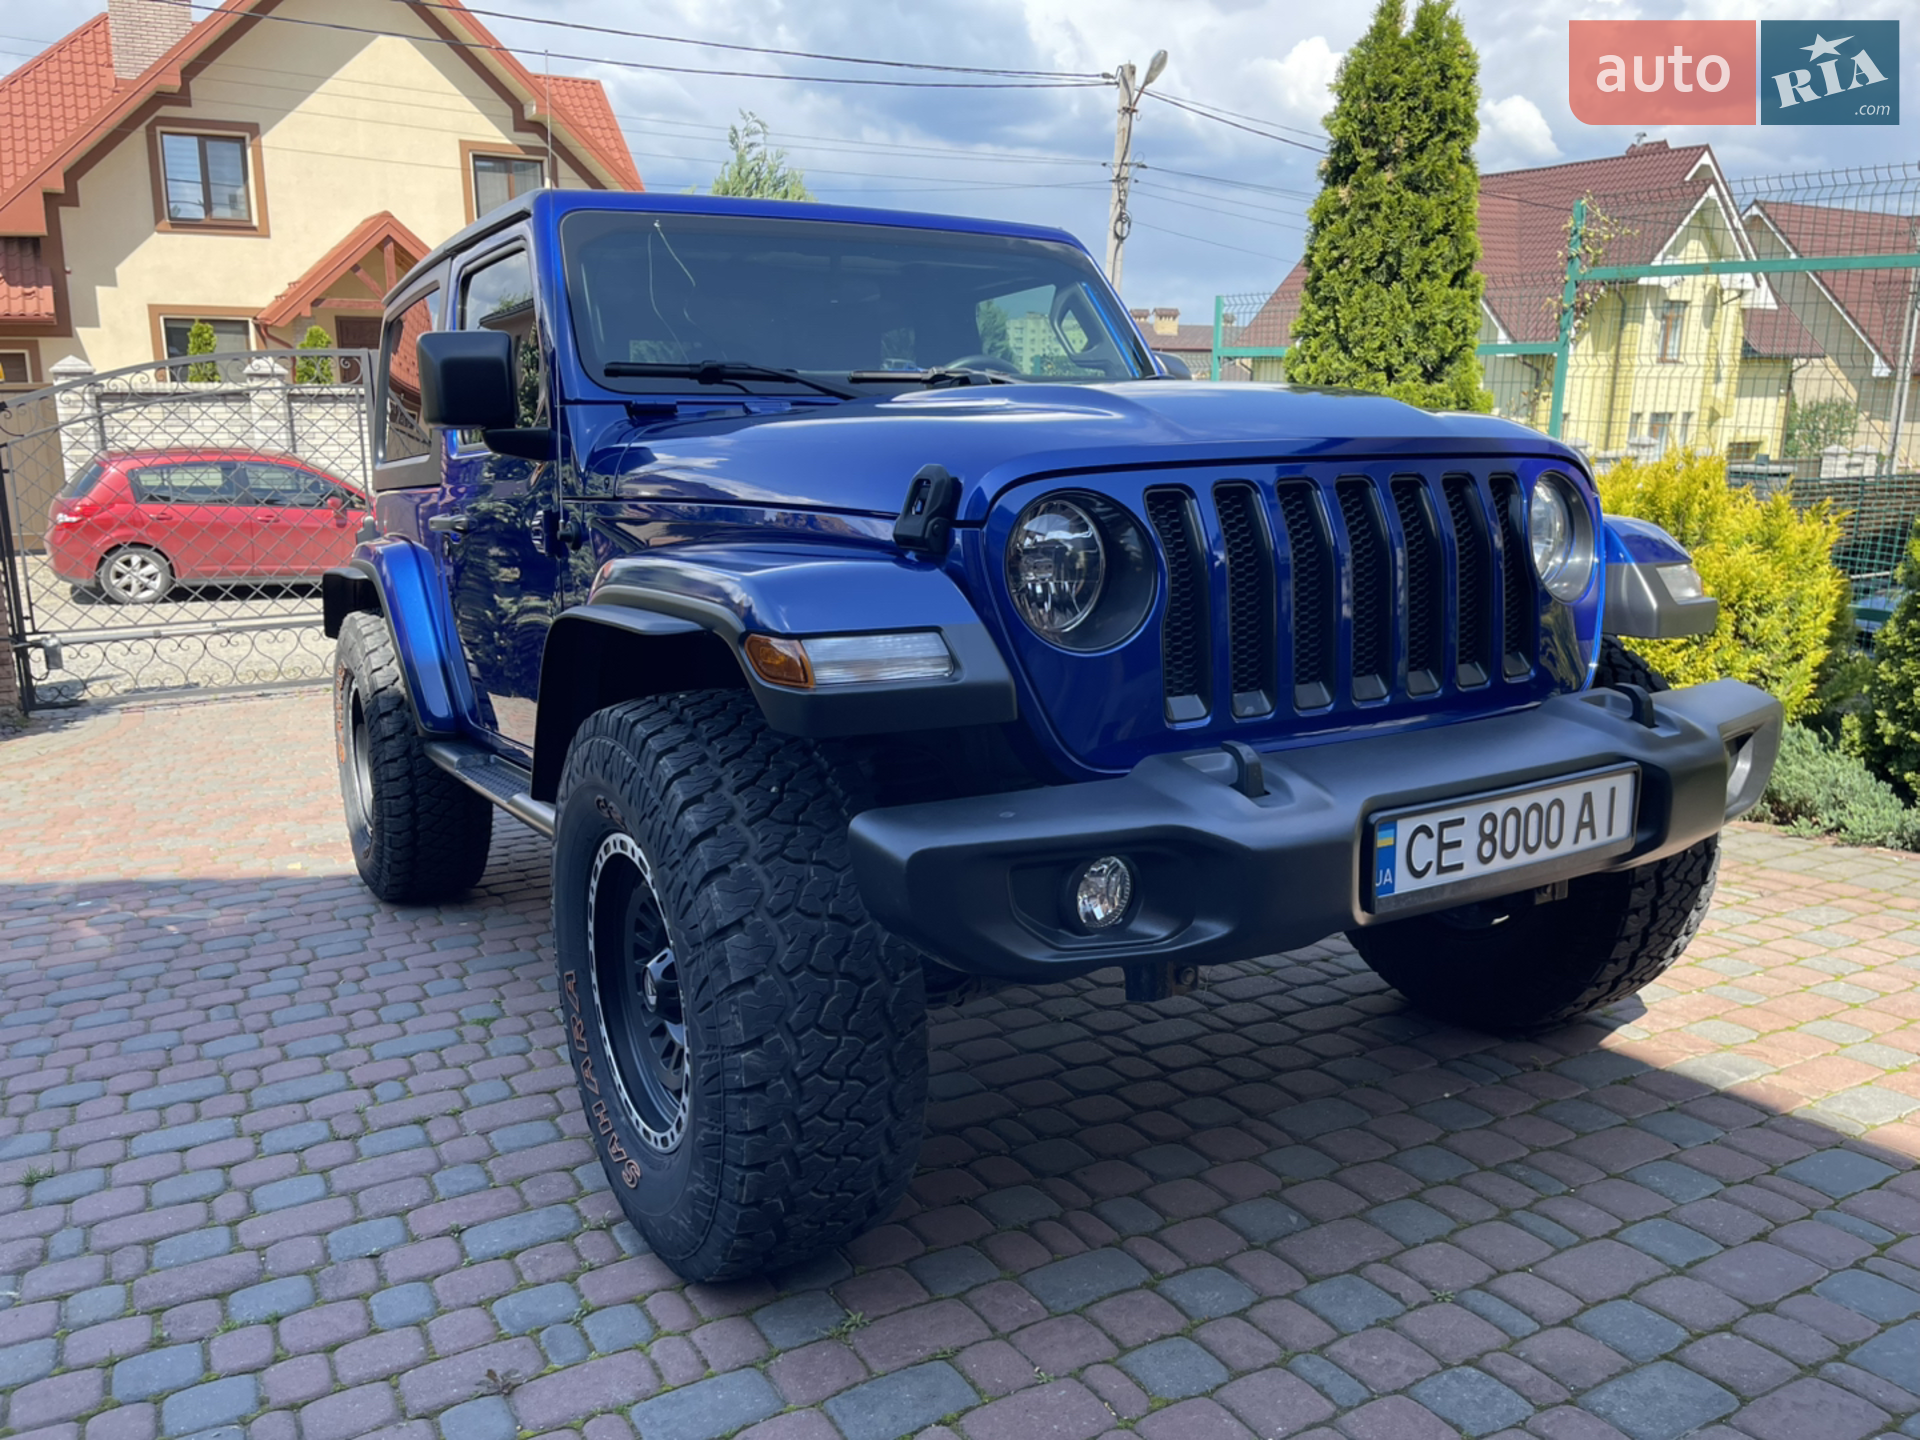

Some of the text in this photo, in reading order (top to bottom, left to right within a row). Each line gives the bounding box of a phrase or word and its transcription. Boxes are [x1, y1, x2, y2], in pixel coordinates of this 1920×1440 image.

[1406, 816, 1466, 879] CE
[1476, 798, 1566, 865] 8000
[563, 969, 642, 1189] SAHARA
